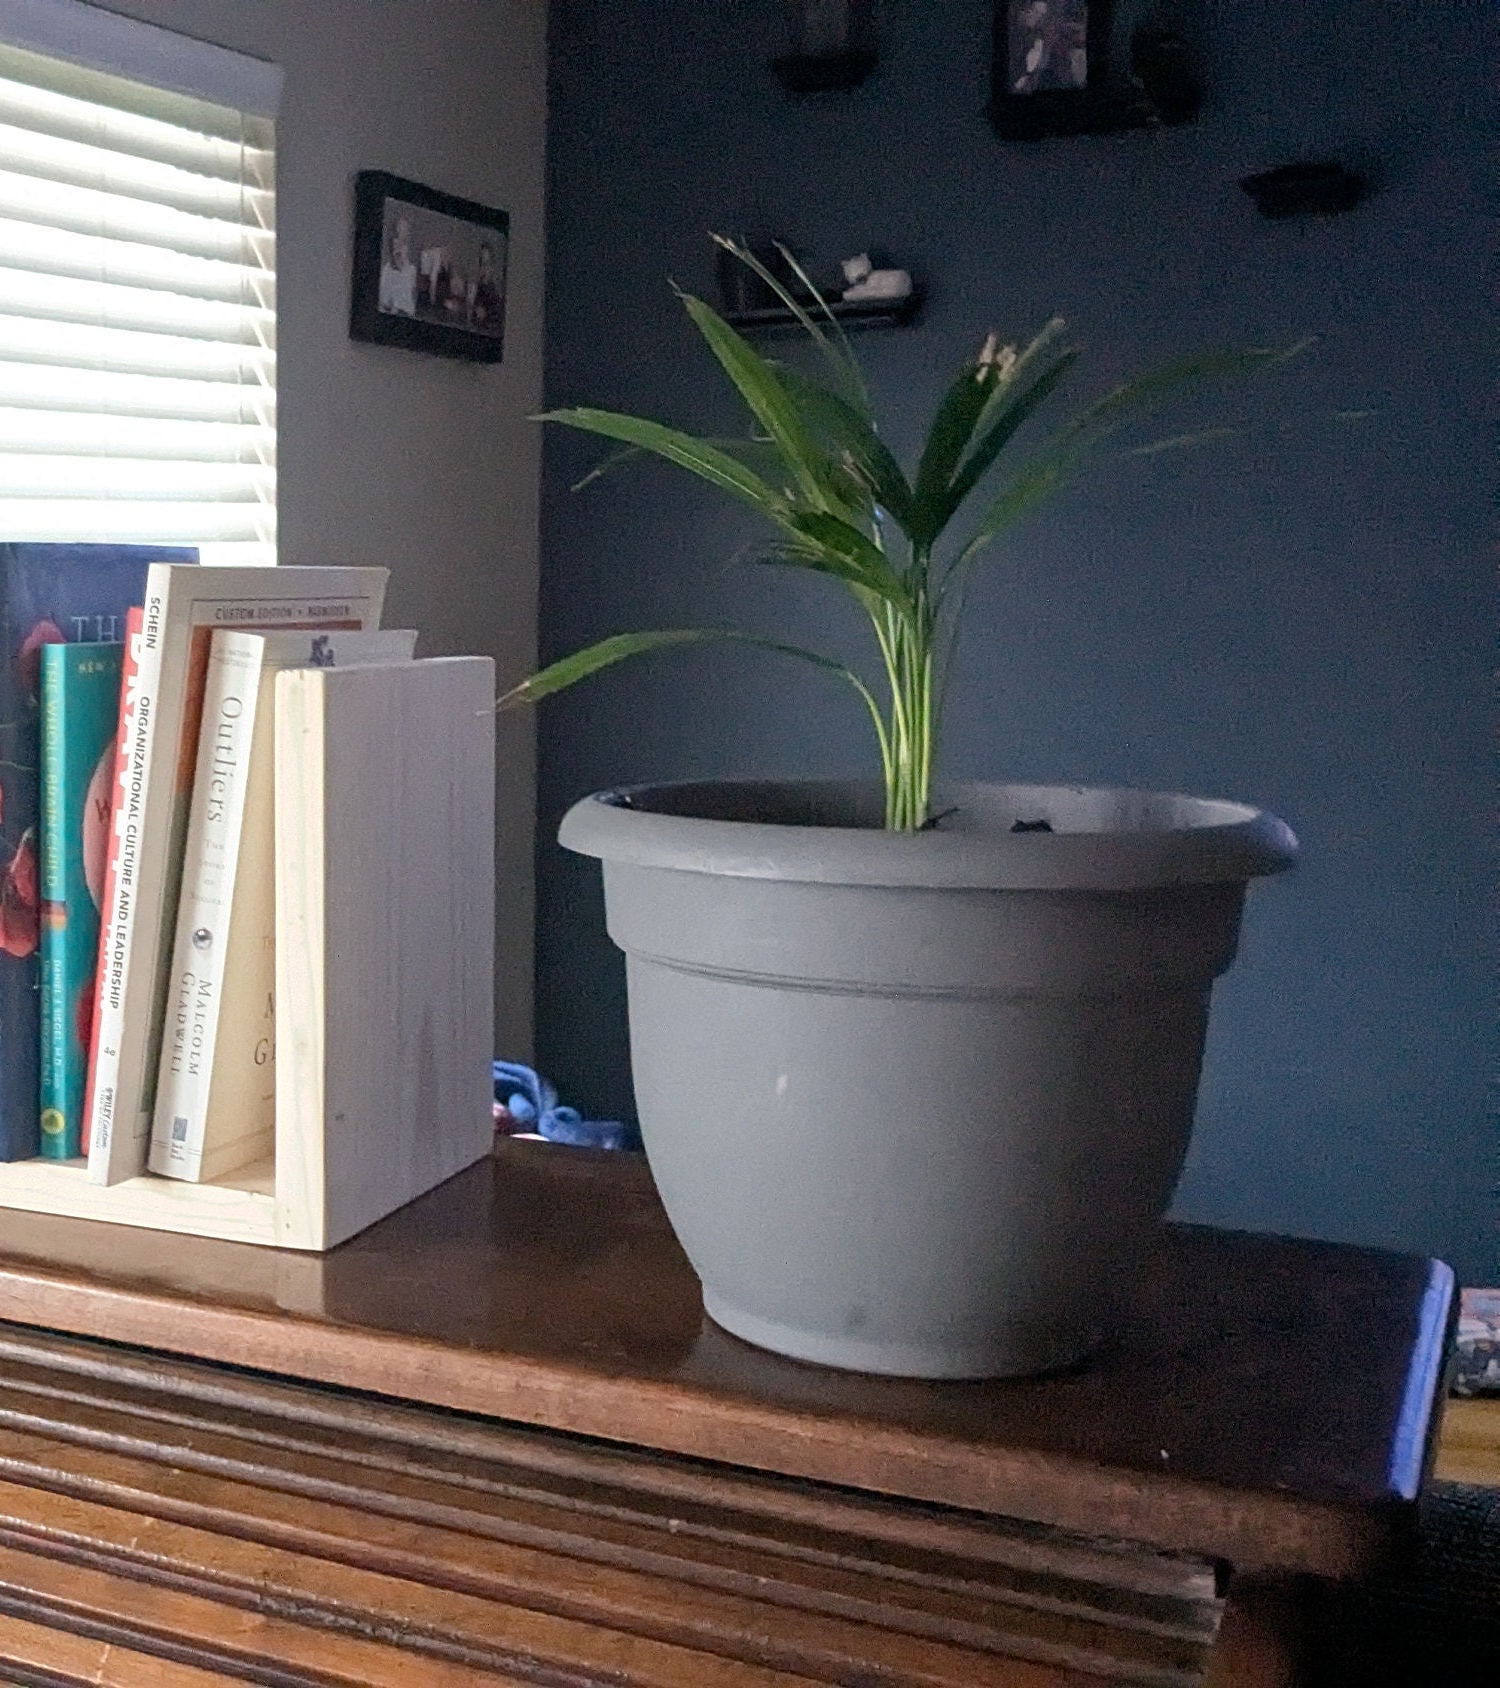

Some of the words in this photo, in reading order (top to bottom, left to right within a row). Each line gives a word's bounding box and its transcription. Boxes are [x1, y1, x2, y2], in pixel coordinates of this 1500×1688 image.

[70, 615, 118, 643] TH
[145, 596, 161, 650] SCHEIN
[127, 696, 150, 820] ORGANIZATIONAL
[207, 696, 244, 823] Outliers
[121, 824, 137, 886] CULTURE
[116, 890, 131, 921] AND
[109, 922, 127, 1010] LEADERSHIP
[170, 971, 196, 1077] GLADWELL
[187, 978, 213, 1076] MALCOLM
[103, 1092, 113, 1120] WILEY
